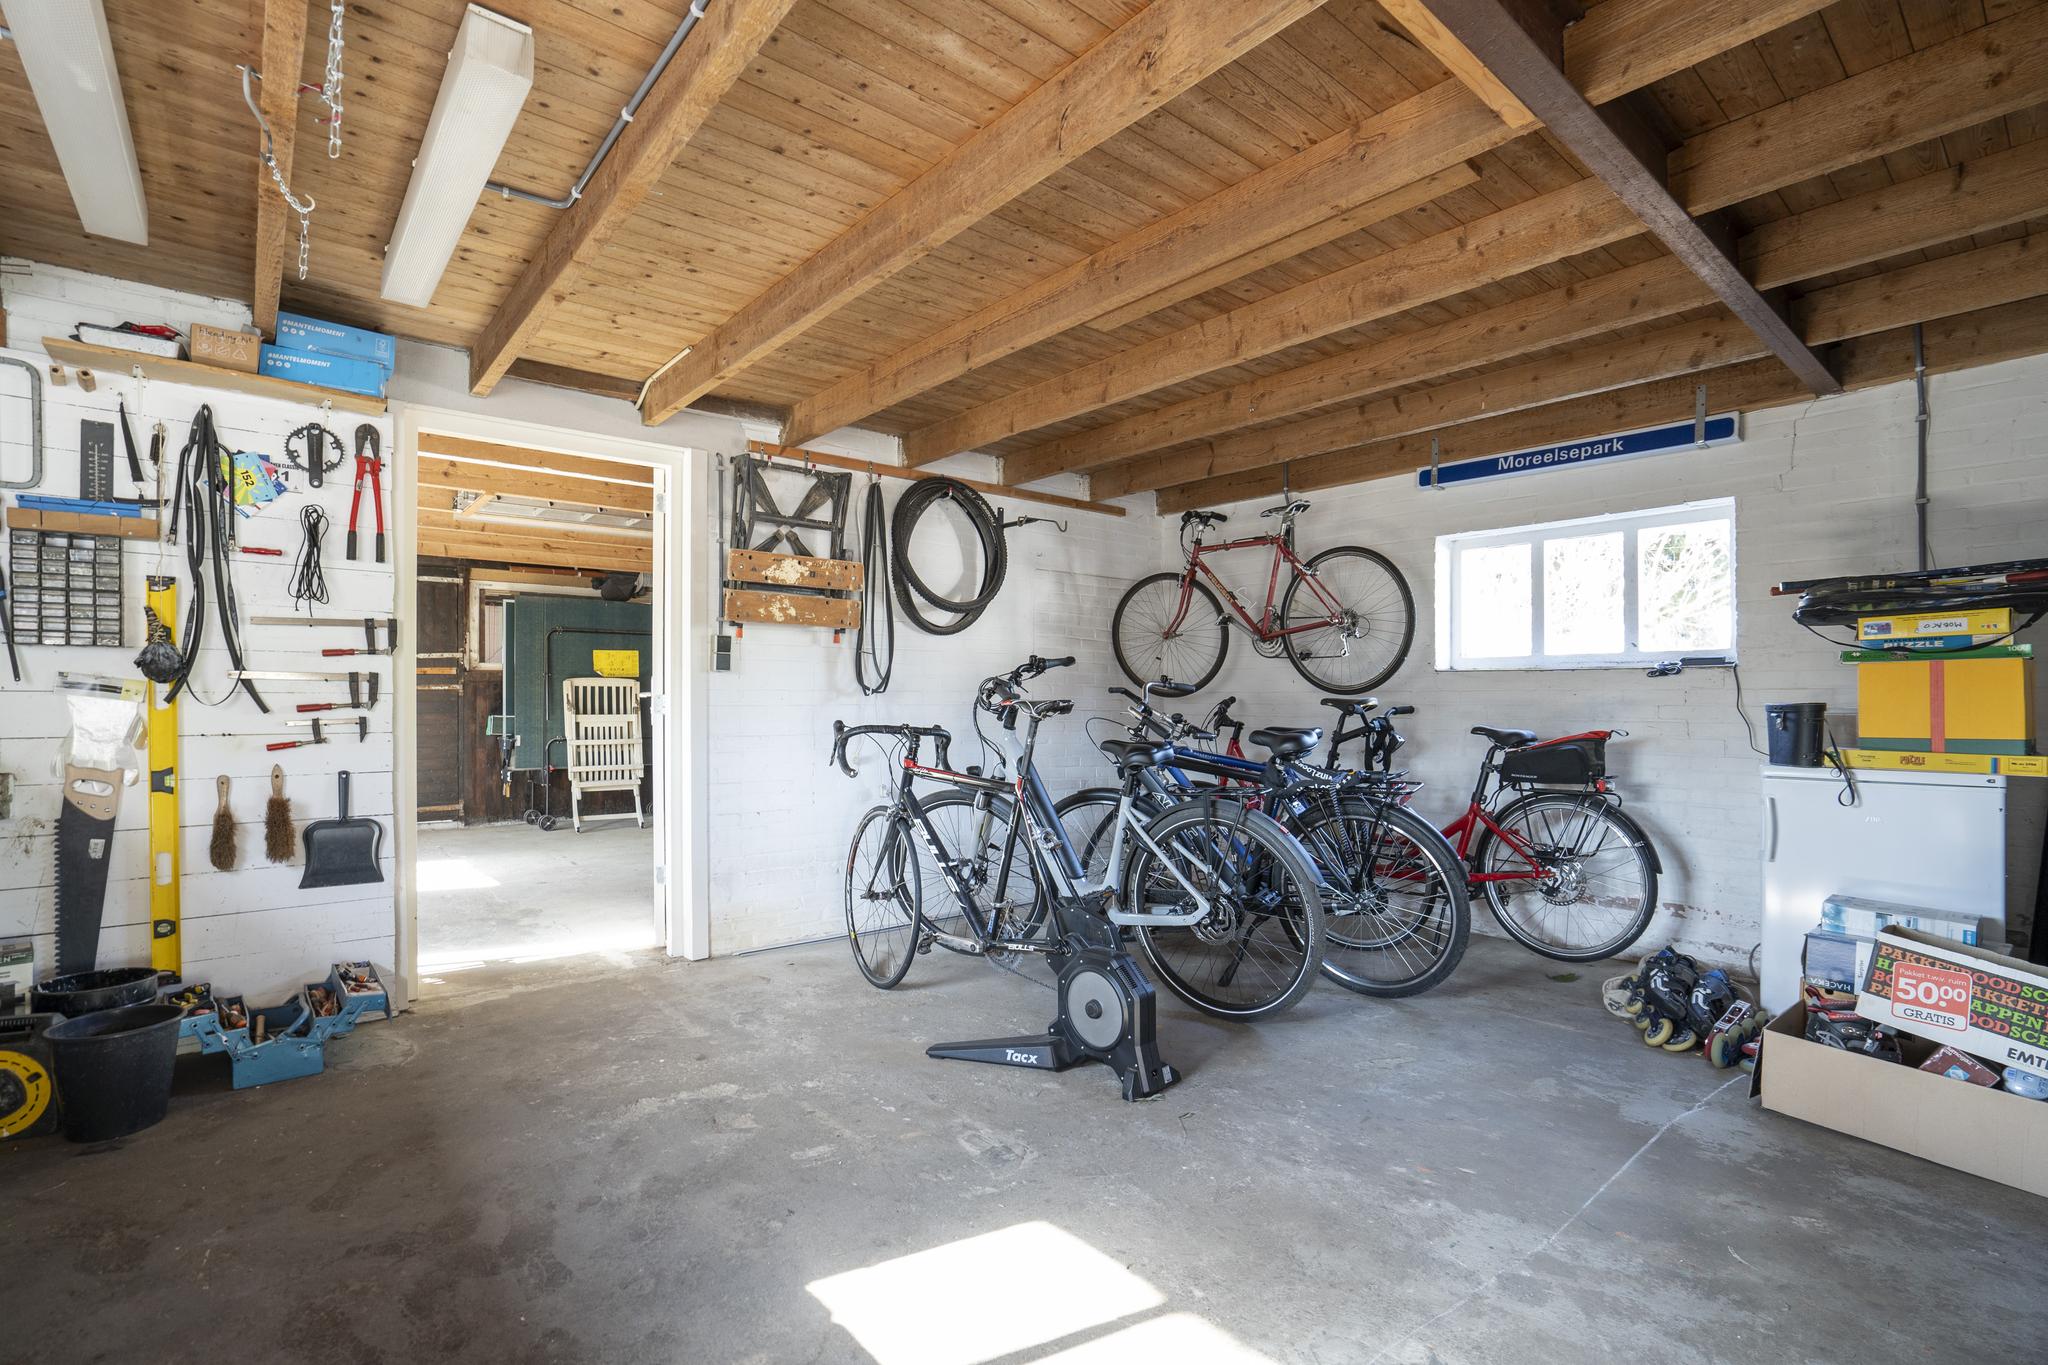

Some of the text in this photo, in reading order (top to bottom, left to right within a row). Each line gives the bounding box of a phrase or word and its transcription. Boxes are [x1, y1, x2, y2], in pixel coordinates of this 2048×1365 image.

[282, 319, 346, 337] #MANTELMOMENT
[267, 352, 332, 368] #MANTELMOMENT
[1498, 438, 1624, 471] Moreelsepark
[240, 470, 255, 487] 152
[1207, 571, 1234, 604] PEUGEOT
[912, 817, 961, 893] BULLS
[1007, 943, 1036, 952] BULLS
[1809, 977, 1851, 992] HACEKA
[1899, 967, 1925, 979] Pakket
[1948, 978, 1967, 986] ruim
[1903, 1007, 1955, 1026] GRATIS
[1006, 1049, 1038, 1064] Tacx
[2007, 1047, 2048, 1070] EMT
